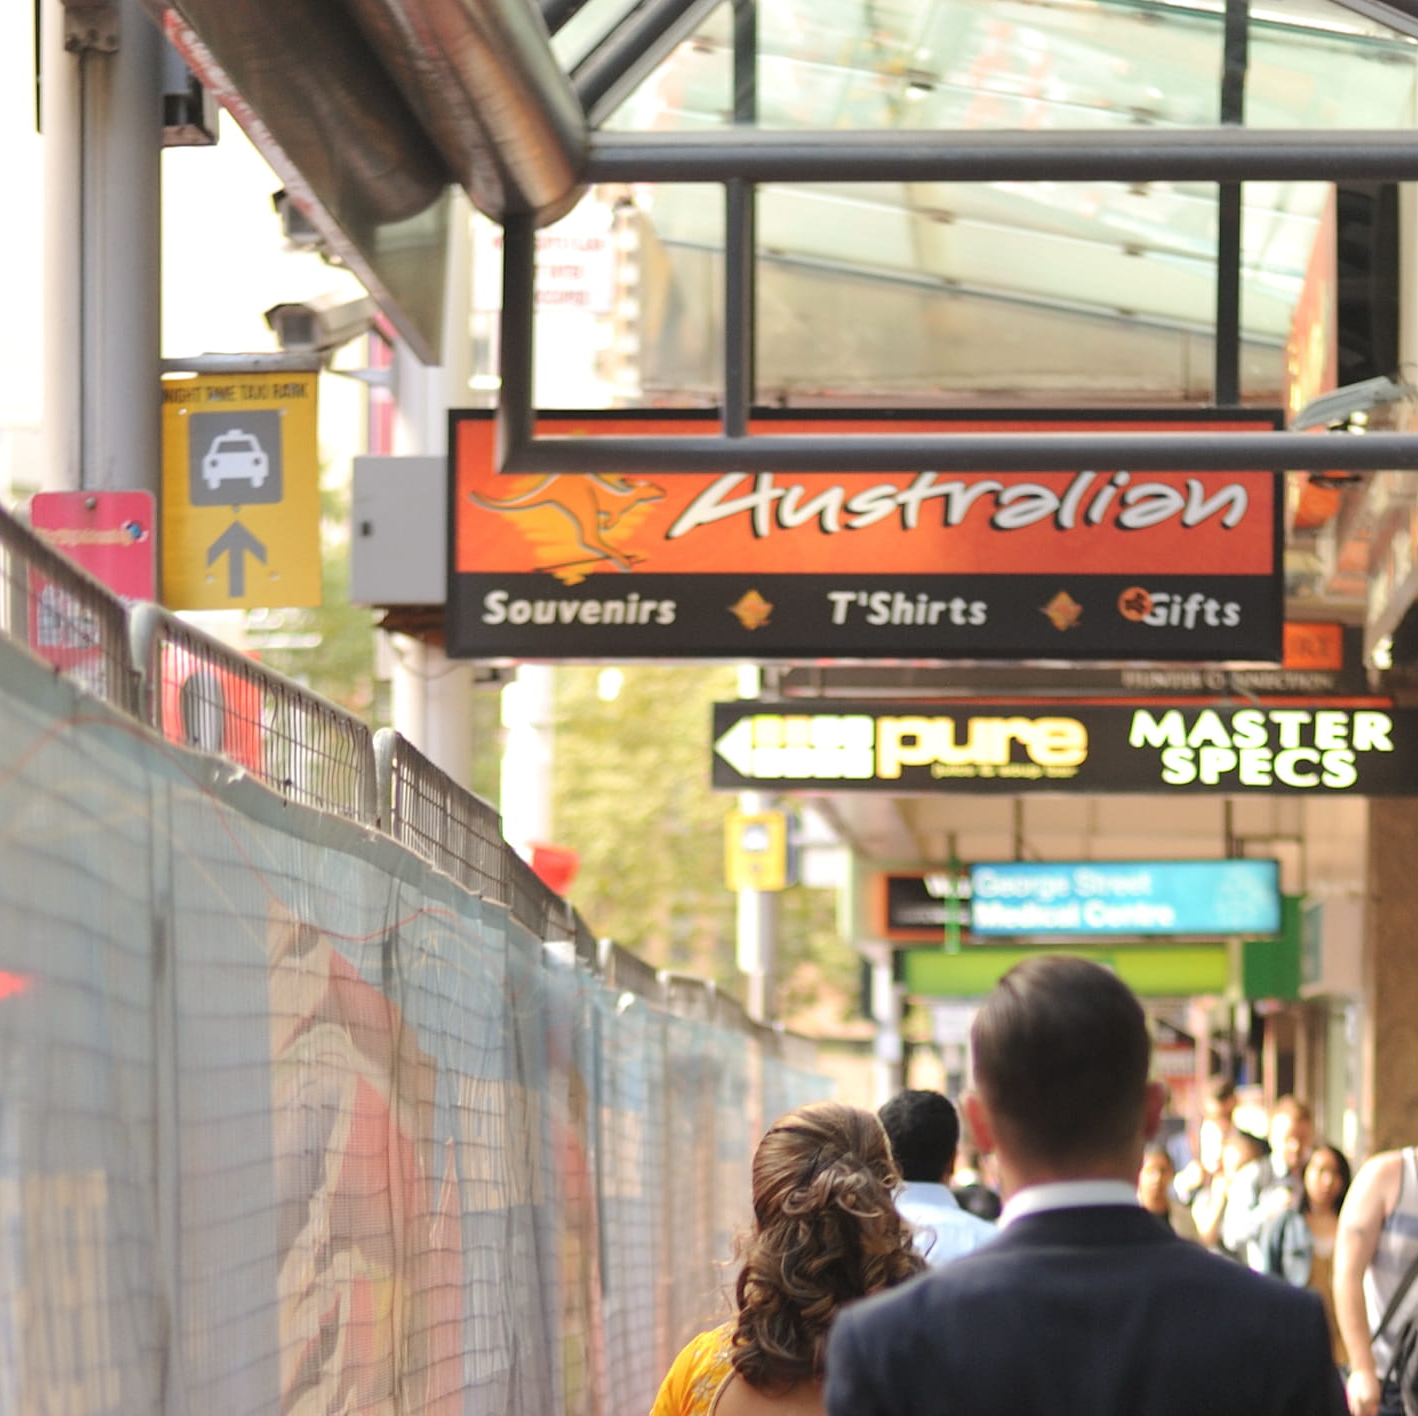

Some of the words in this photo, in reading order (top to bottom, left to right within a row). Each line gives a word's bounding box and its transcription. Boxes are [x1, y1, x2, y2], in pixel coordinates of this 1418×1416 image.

[666, 471, 1249, 539] Australian
[481, 590, 677, 626] Souvenirs
[827, 590, 989, 626] T'Shirts
[1141, 592, 1241, 630] Gifts
[875, 714, 1089, 780] pure
[1128, 708, 1395, 752] MASTER
[1160, 746, 1359, 789] SPECS
